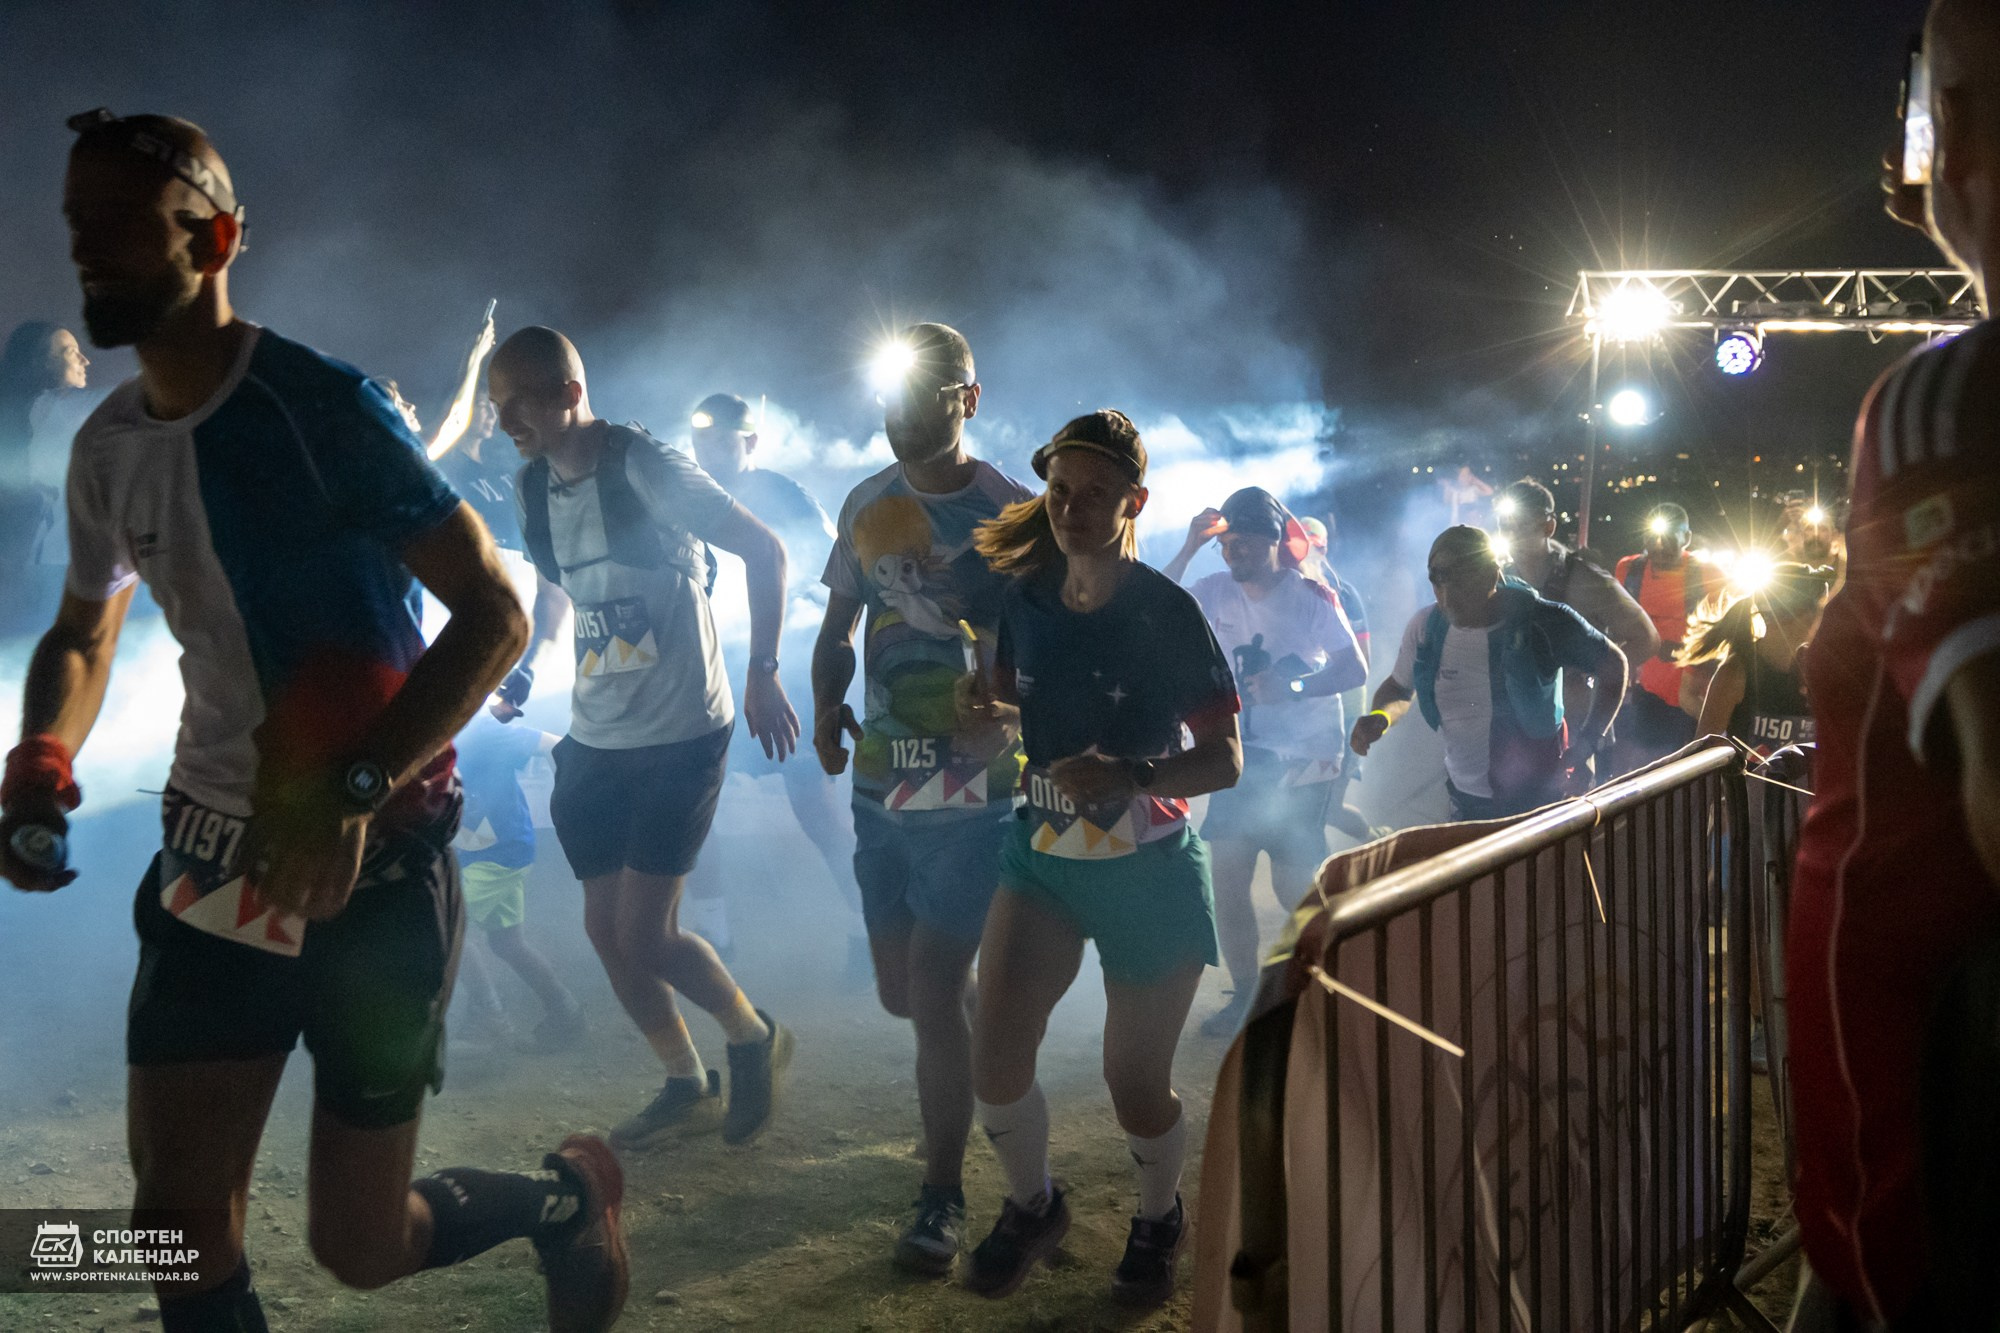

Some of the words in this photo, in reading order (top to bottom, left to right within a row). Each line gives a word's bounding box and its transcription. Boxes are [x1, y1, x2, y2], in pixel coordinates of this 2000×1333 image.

[576, 610, 609, 638] 0151
[1754, 716, 1793, 740] 1150
[891, 738, 936, 768] 1125
[172, 804, 246, 867] 1197
